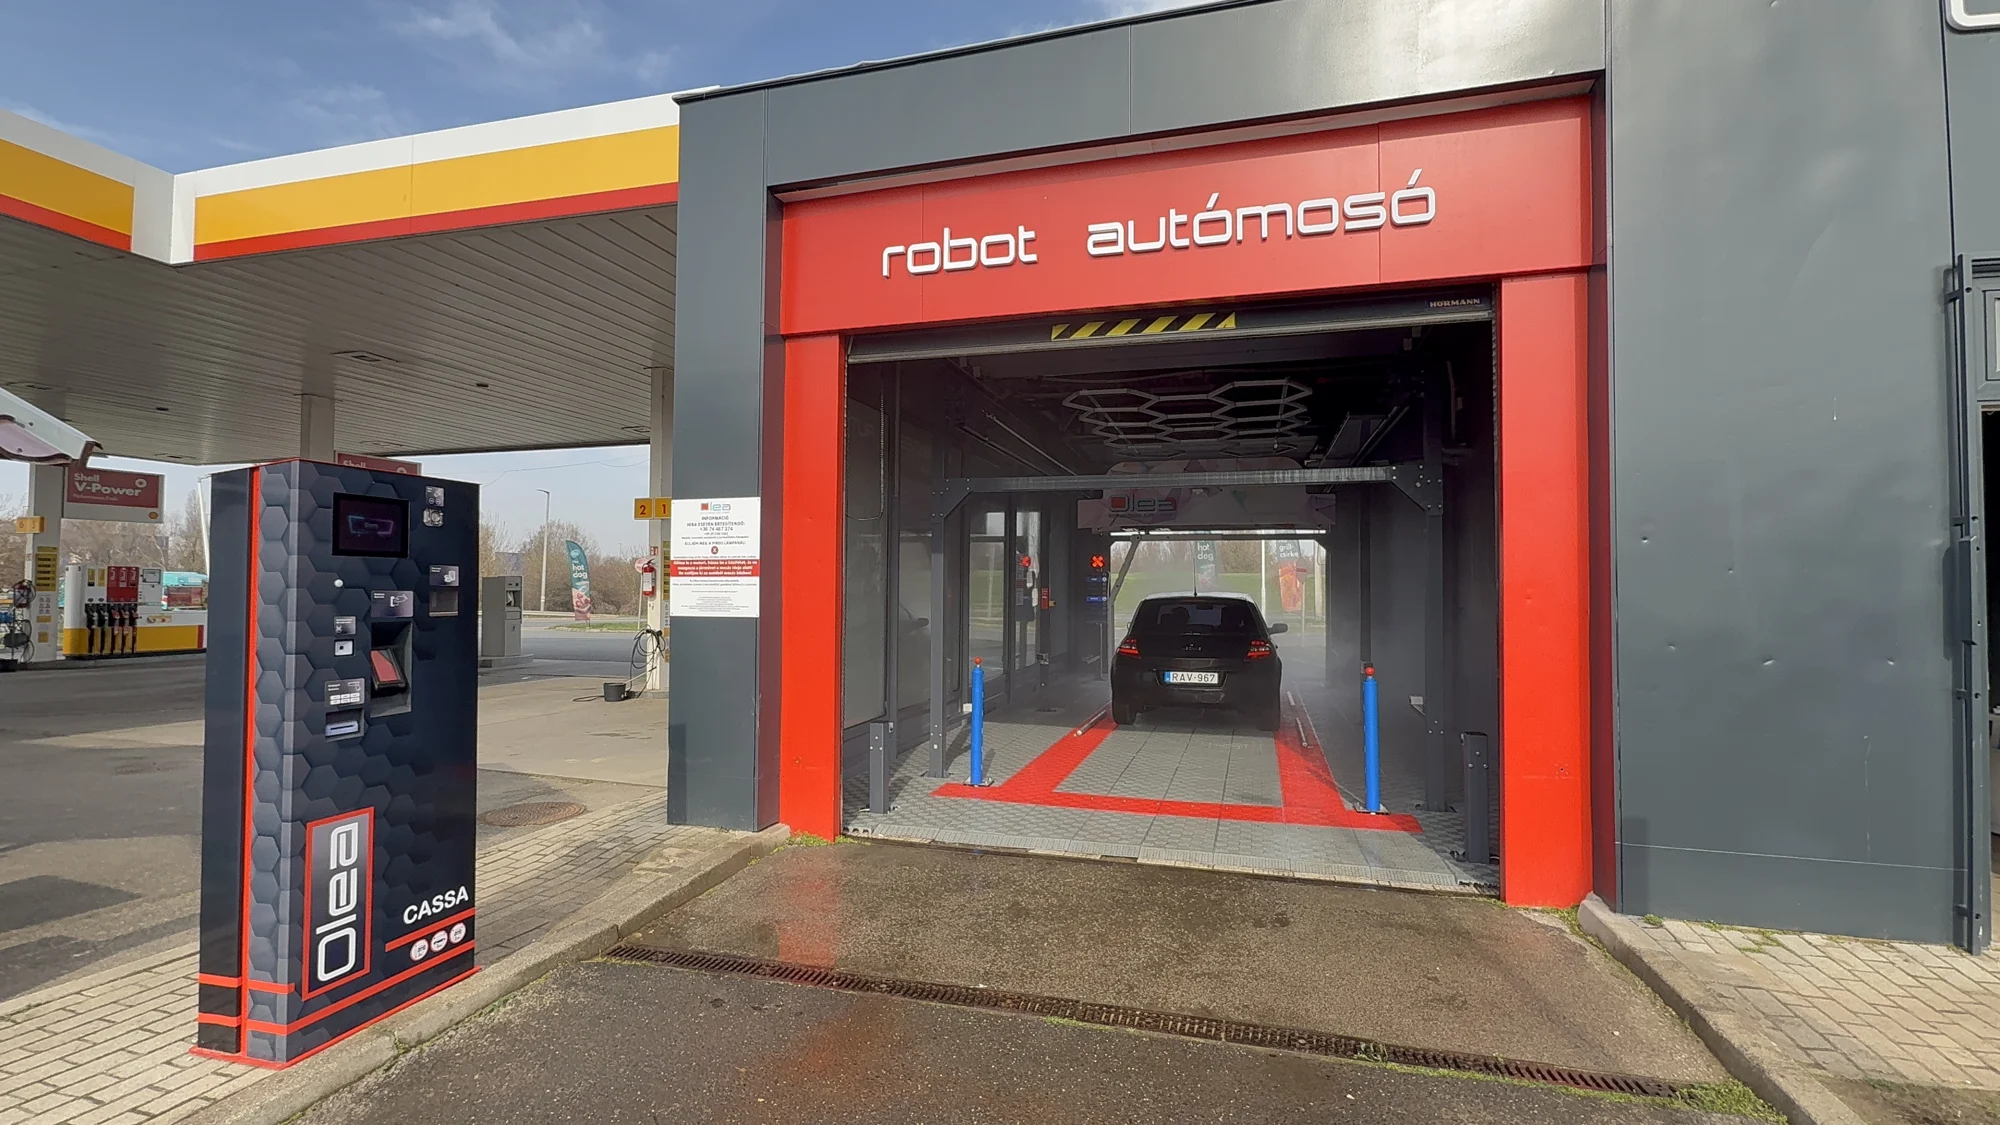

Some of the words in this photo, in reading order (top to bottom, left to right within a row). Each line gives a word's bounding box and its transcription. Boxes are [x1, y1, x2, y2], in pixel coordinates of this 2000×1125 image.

[882, 225, 1038, 278] robot
[1087, 168, 1436, 256] autómosó
[74, 473, 100, 482] Shell
[74, 481, 142, 496] V-Power
[640, 505, 646, 515] 2
[662, 504, 666, 514] 1
[1197, 542, 1210, 551] hot
[1197, 551, 1214, 561] dog
[572, 563, 585, 571] hot
[572, 570, 588, 579] dog
[1172, 673, 1216, 682] RAV-967
[403, 886, 469, 924] CASSA
